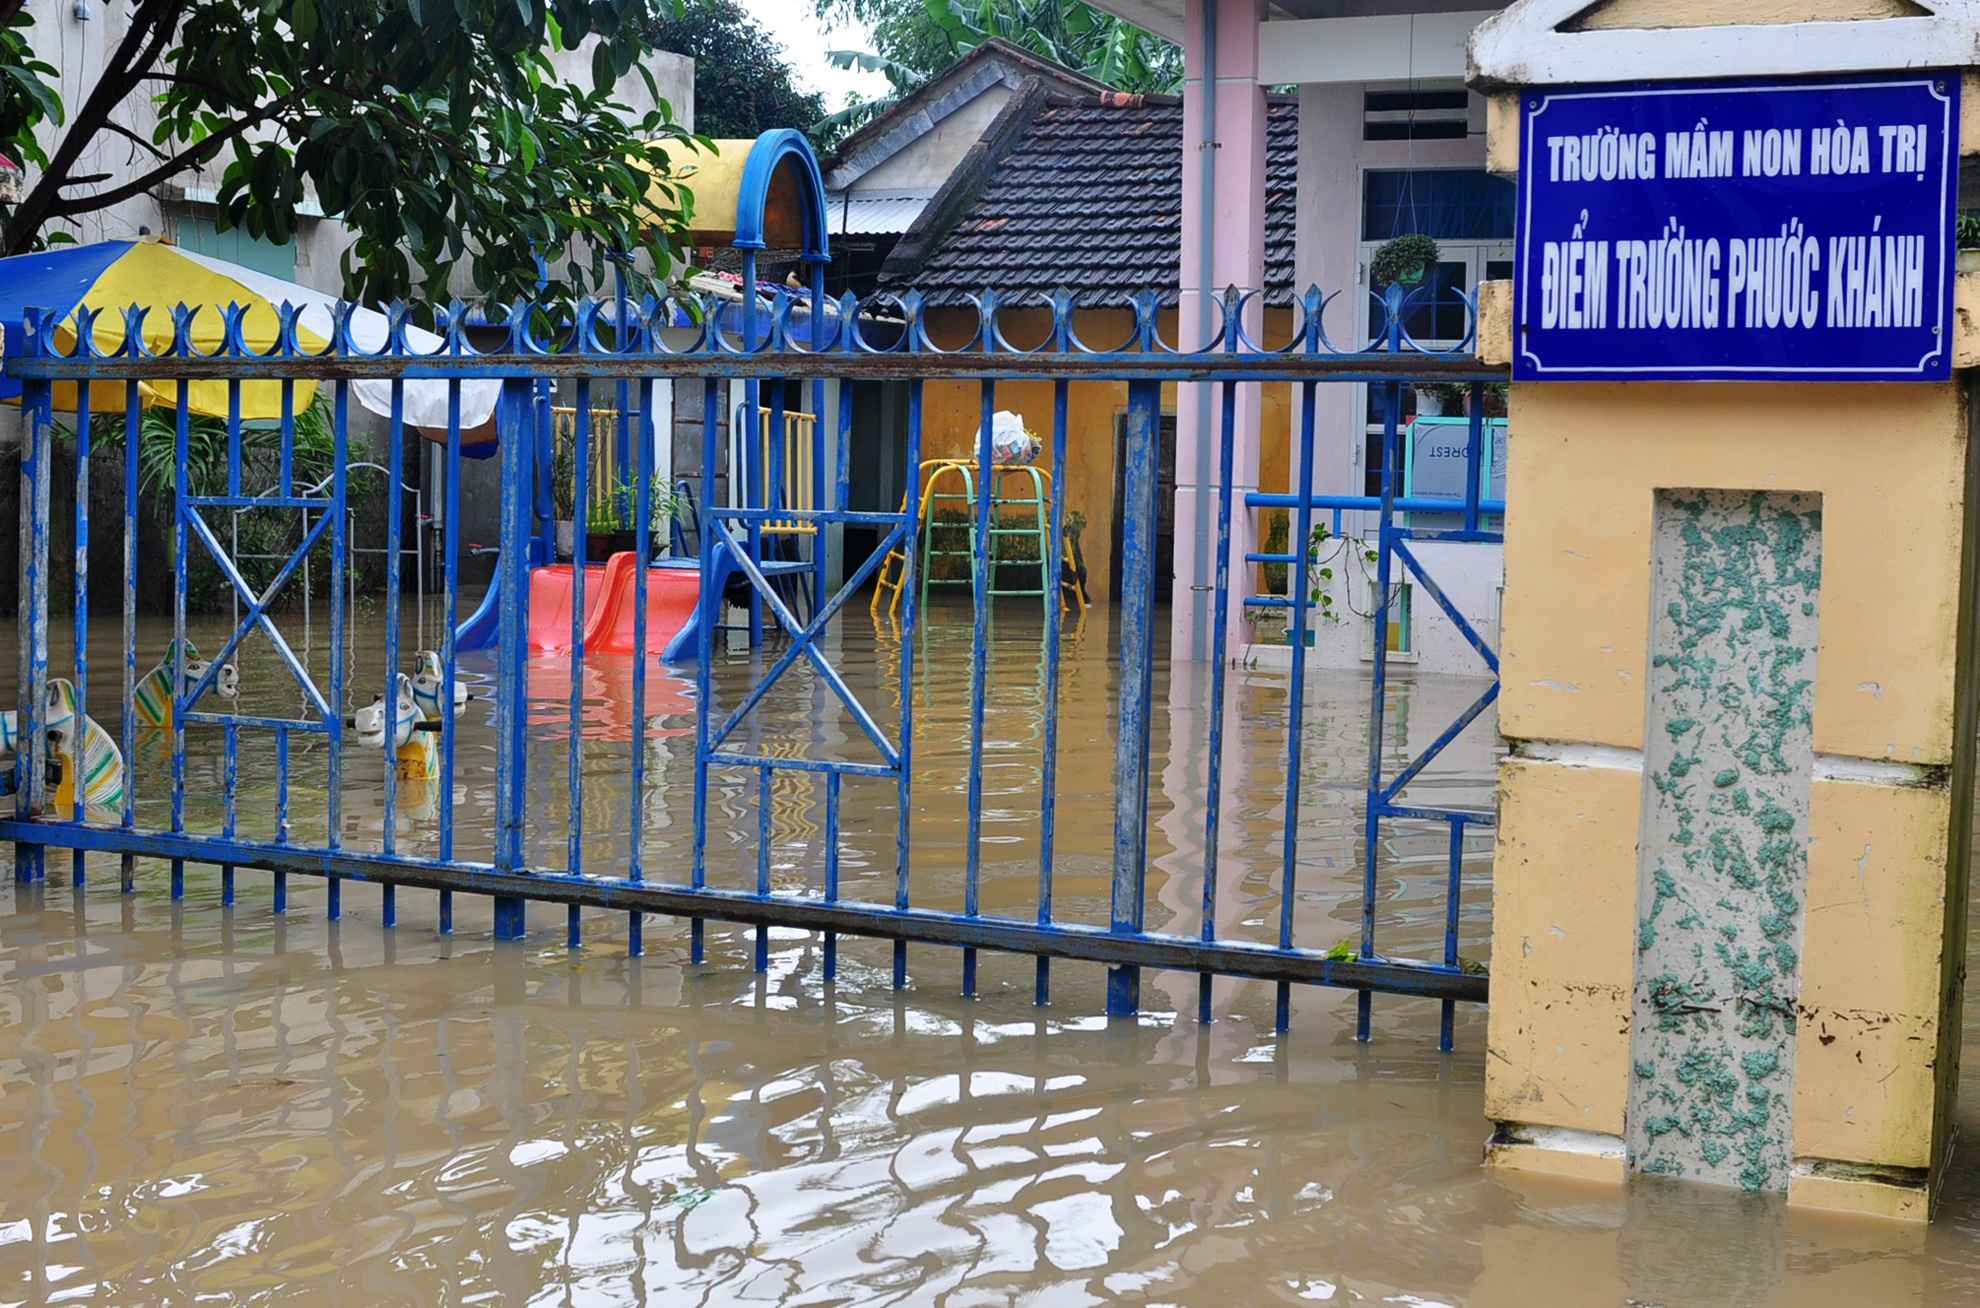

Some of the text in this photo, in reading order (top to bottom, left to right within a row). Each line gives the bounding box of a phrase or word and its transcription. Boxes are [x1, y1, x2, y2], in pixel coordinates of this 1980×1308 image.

[1547, 117, 1927, 182] TRƯỜNG MẦM NON HÒA TRỊ
[1542, 209, 1925, 330] ĐIỂM TRƯỜNG PHƯỚC KHÁNH
